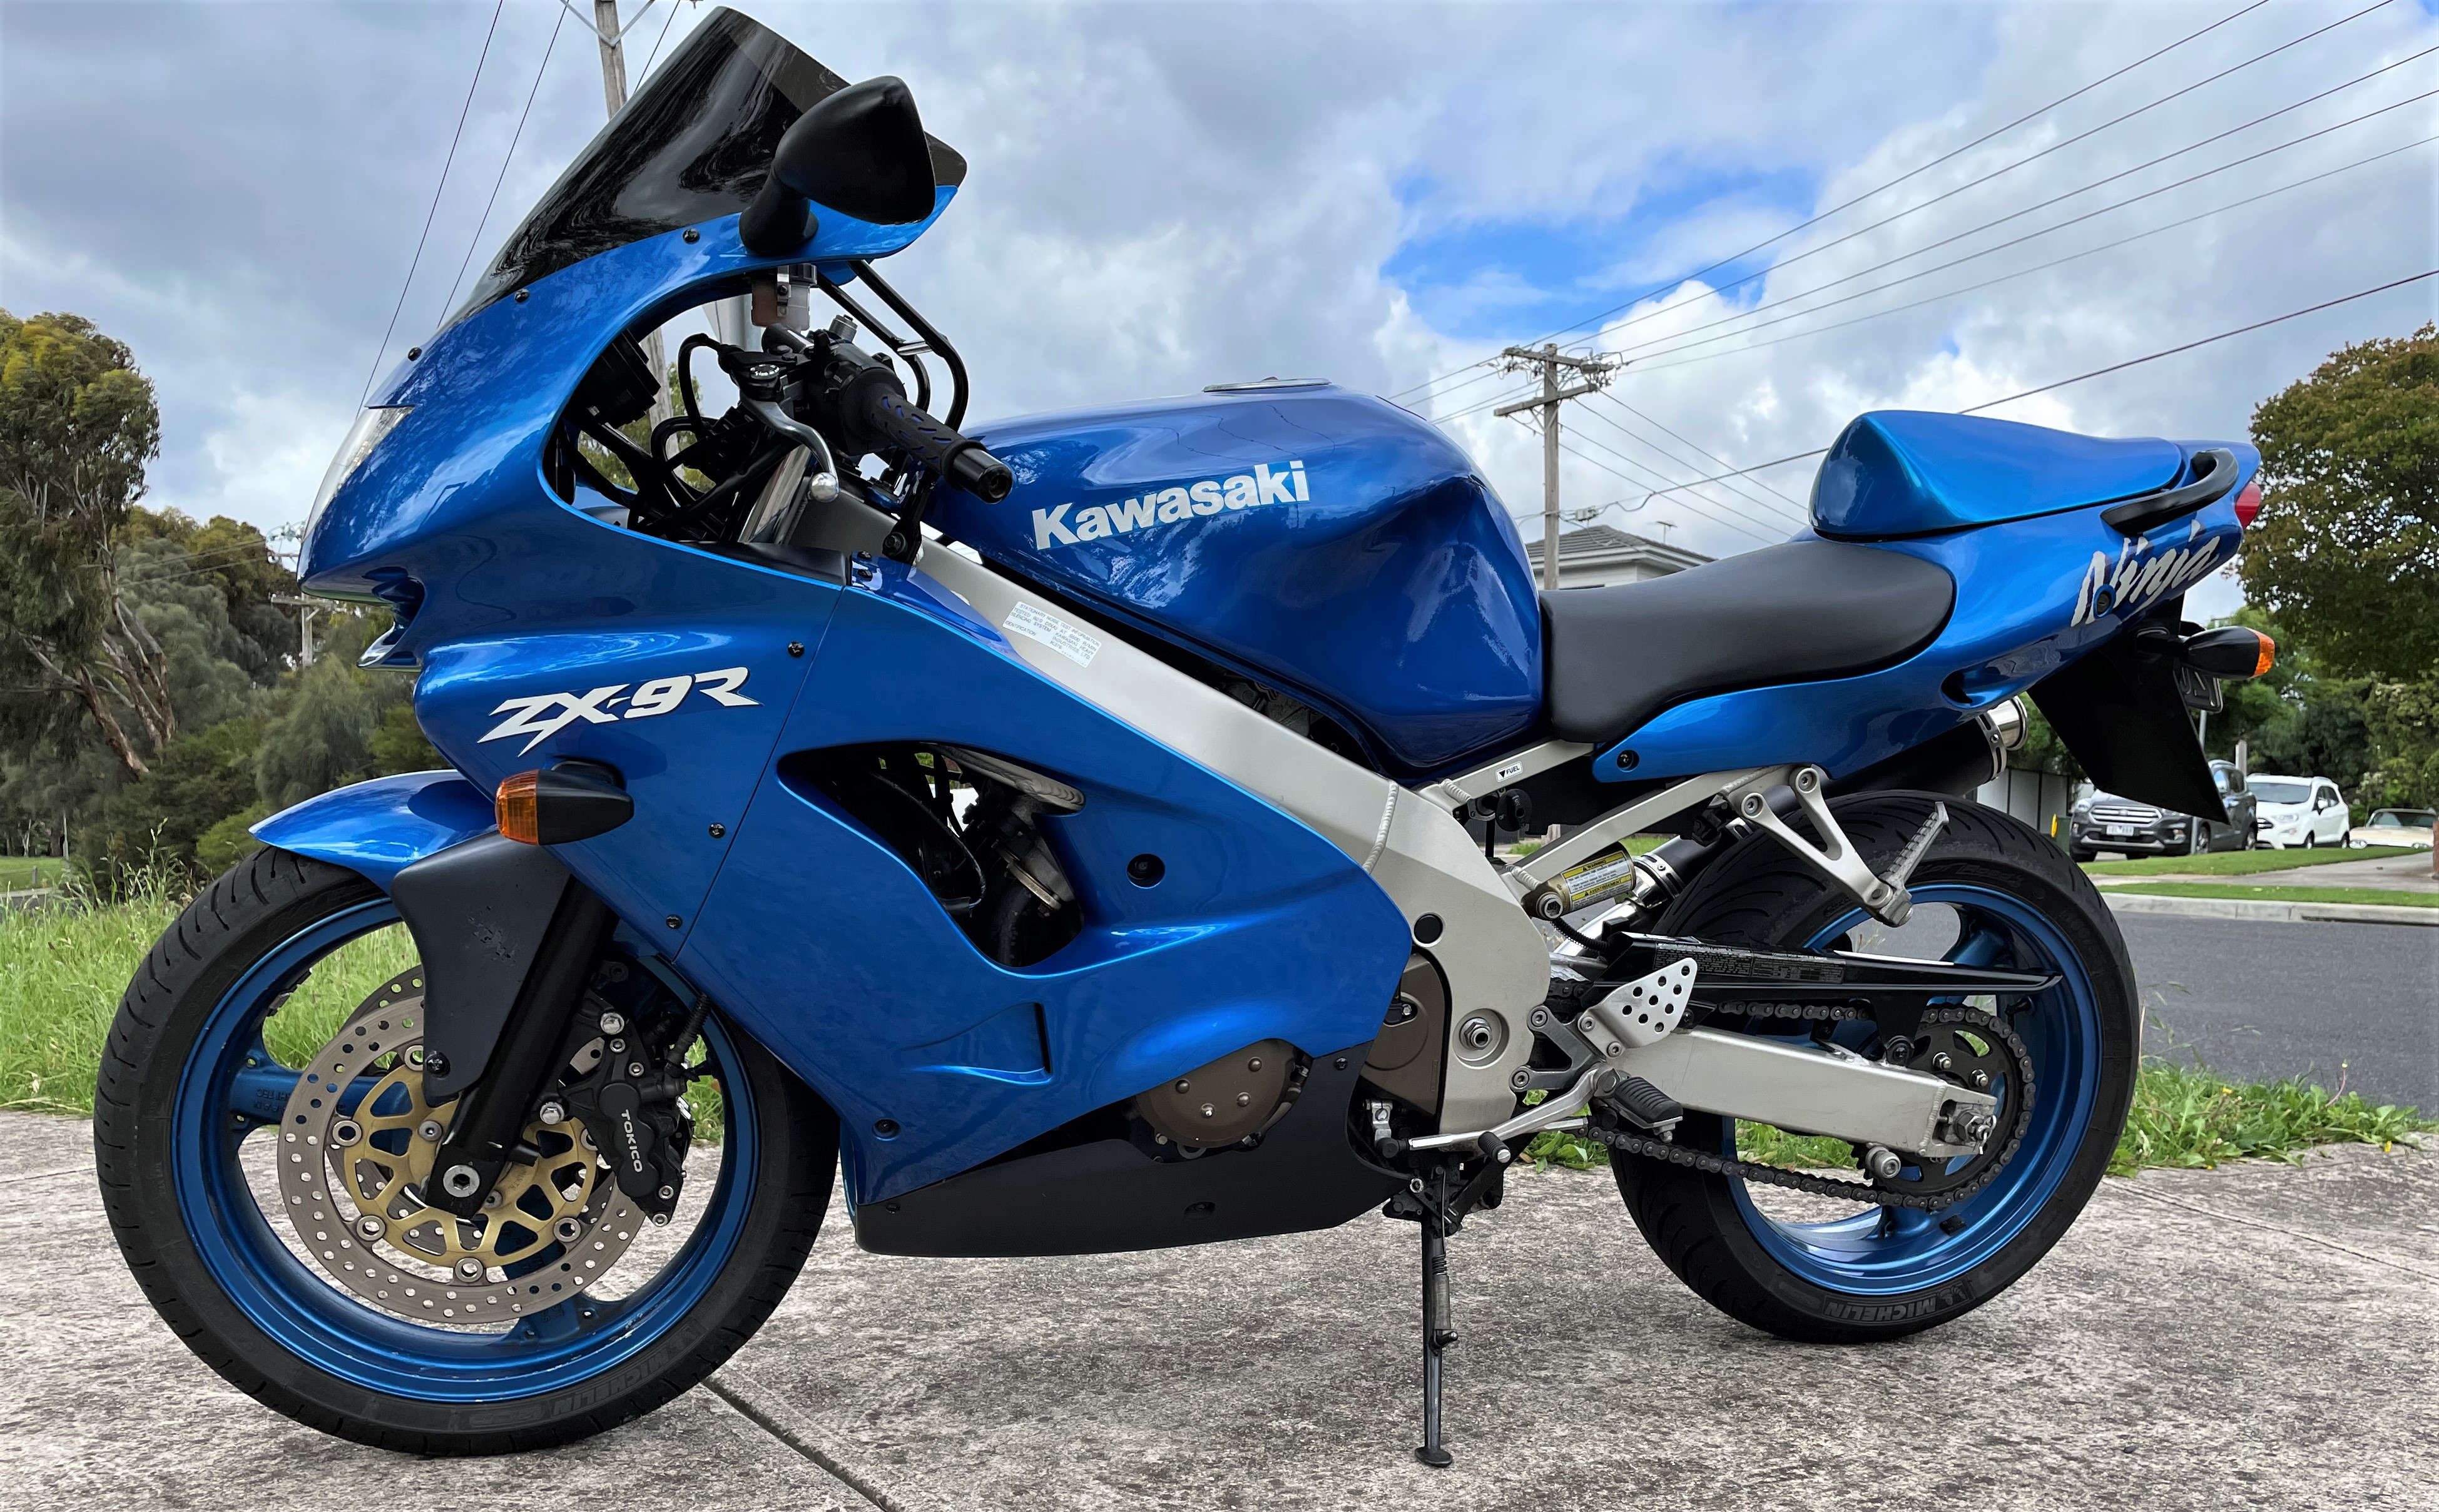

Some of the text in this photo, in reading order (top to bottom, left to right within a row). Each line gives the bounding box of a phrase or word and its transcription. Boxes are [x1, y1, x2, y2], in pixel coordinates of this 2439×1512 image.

[1032, 460, 1310, 551] Kawasaki
[2070, 519, 2221, 627] Ninja
[1004, 620, 1036, 636] IDENTIFICATION
[1010, 611, 1094, 656] SILENCING SYSTEM KAWASAKI HEAVY
[1013, 607, 1031, 617] TESTED
[1019, 603, 1046, 617] STATIONARY
[1046, 616, 1059, 624] NOISE
[1071, 628, 1099, 646] INFORMATION
[476, 667, 761, 758] ZX-9R
[1506, 765, 1520, 776] FUEL
[621, 1109, 643, 1172] TOKICO
[1825, 1297, 1937, 1321] MICHELIN
[552, 1349, 669, 1415] MICHELIN
